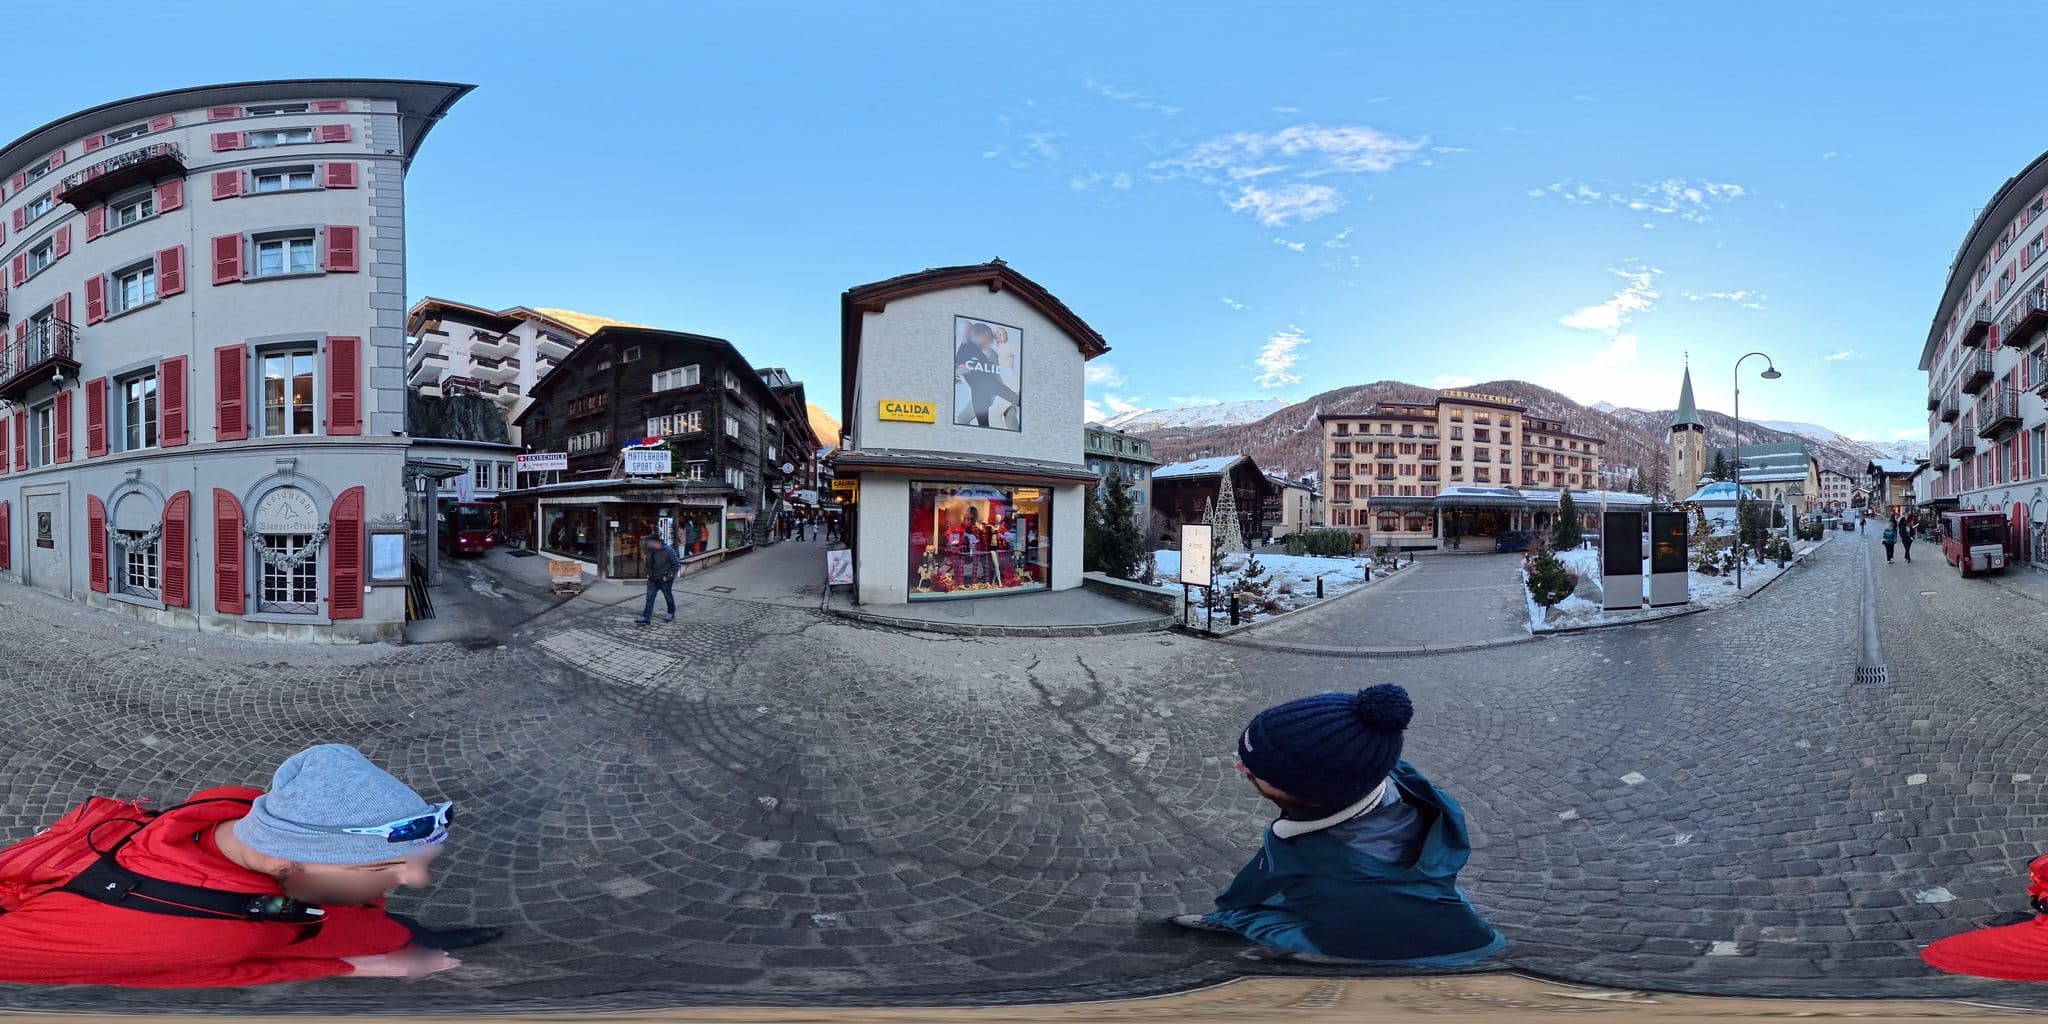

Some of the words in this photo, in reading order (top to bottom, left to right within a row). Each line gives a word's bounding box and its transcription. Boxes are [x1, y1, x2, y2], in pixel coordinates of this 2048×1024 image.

[965, 360, 1001, 375] CALID
[885, 403, 930, 415] CALIDA
[628, 452, 669, 461] MATTERHORN
[632, 462, 652, 471] SPORT
